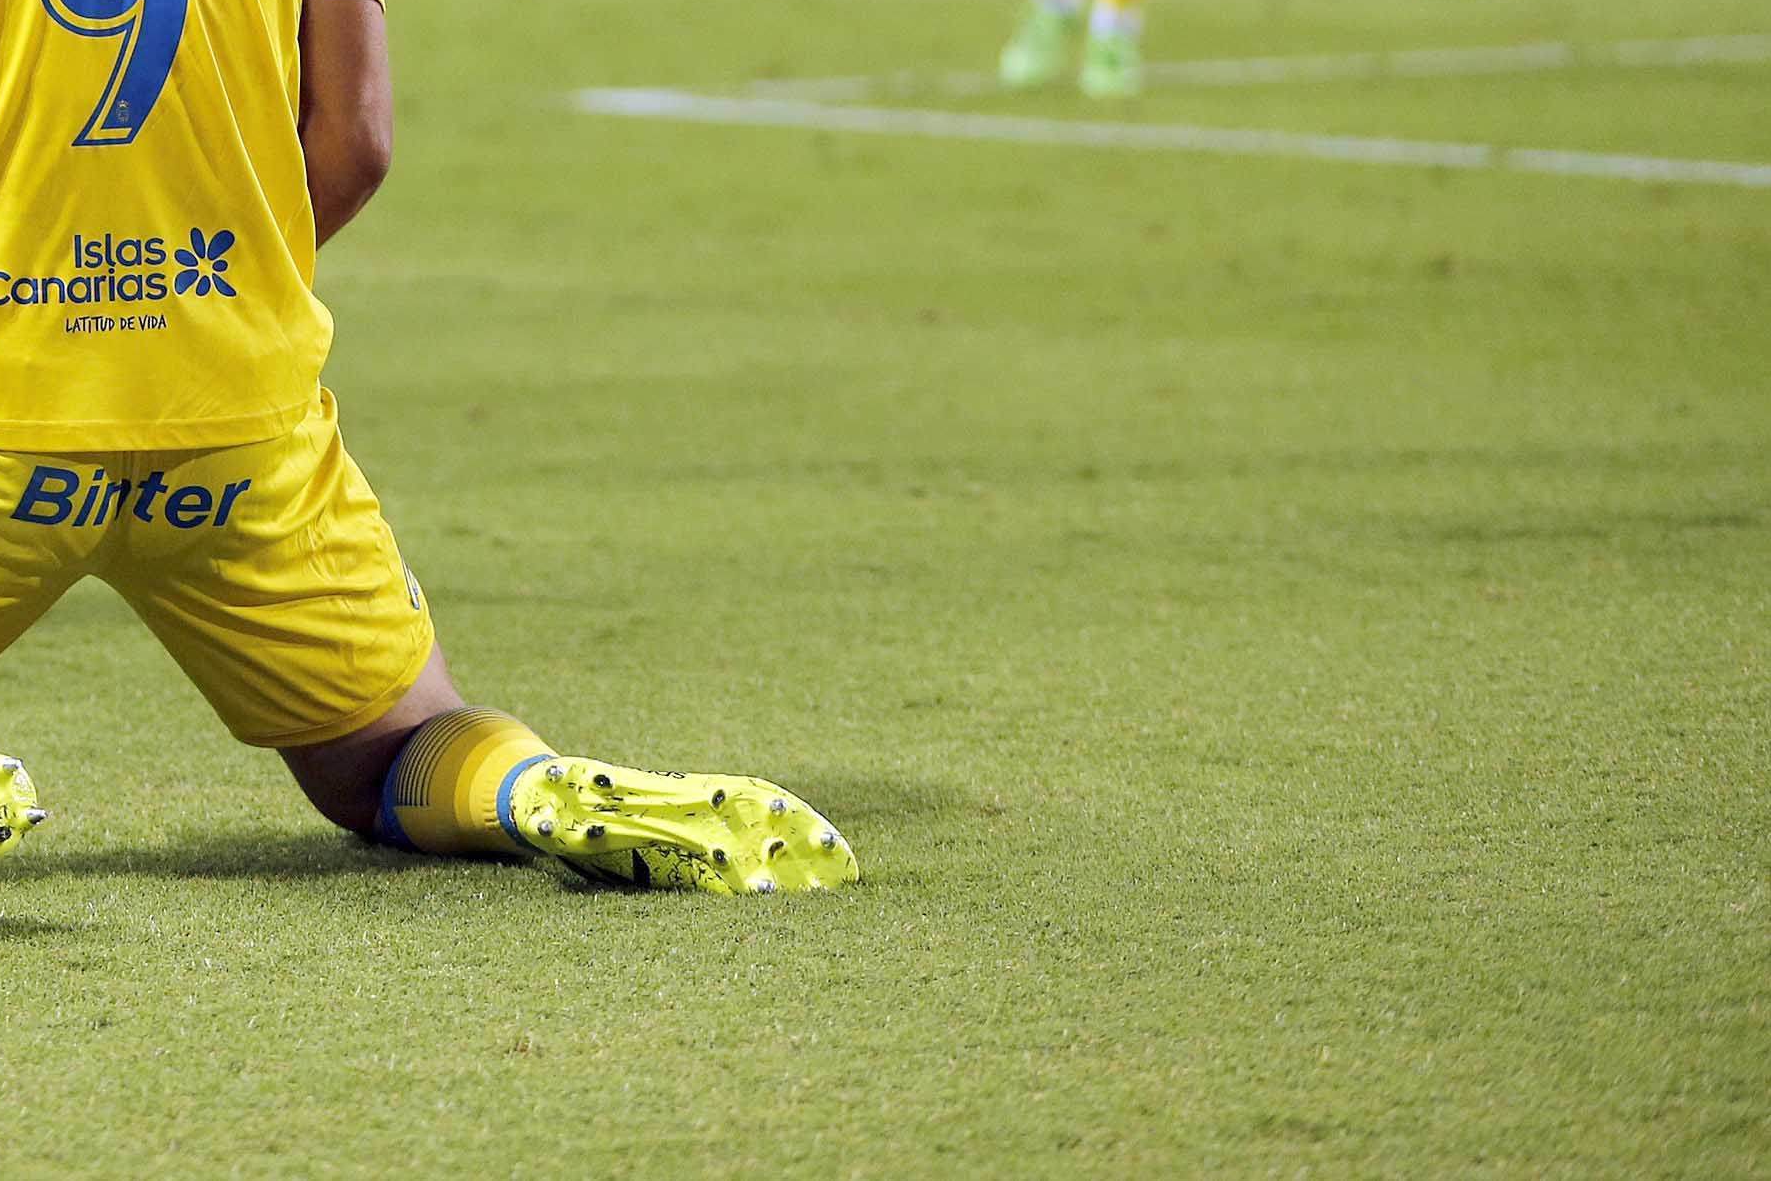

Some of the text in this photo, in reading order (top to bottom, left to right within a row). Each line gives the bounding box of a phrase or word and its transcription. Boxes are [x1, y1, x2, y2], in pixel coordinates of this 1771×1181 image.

[73, 232, 168, 269] Islas
[119, 315, 135, 331] DE
[137, 313, 167, 331] VIDA
[9, 465, 253, 530] Binter
